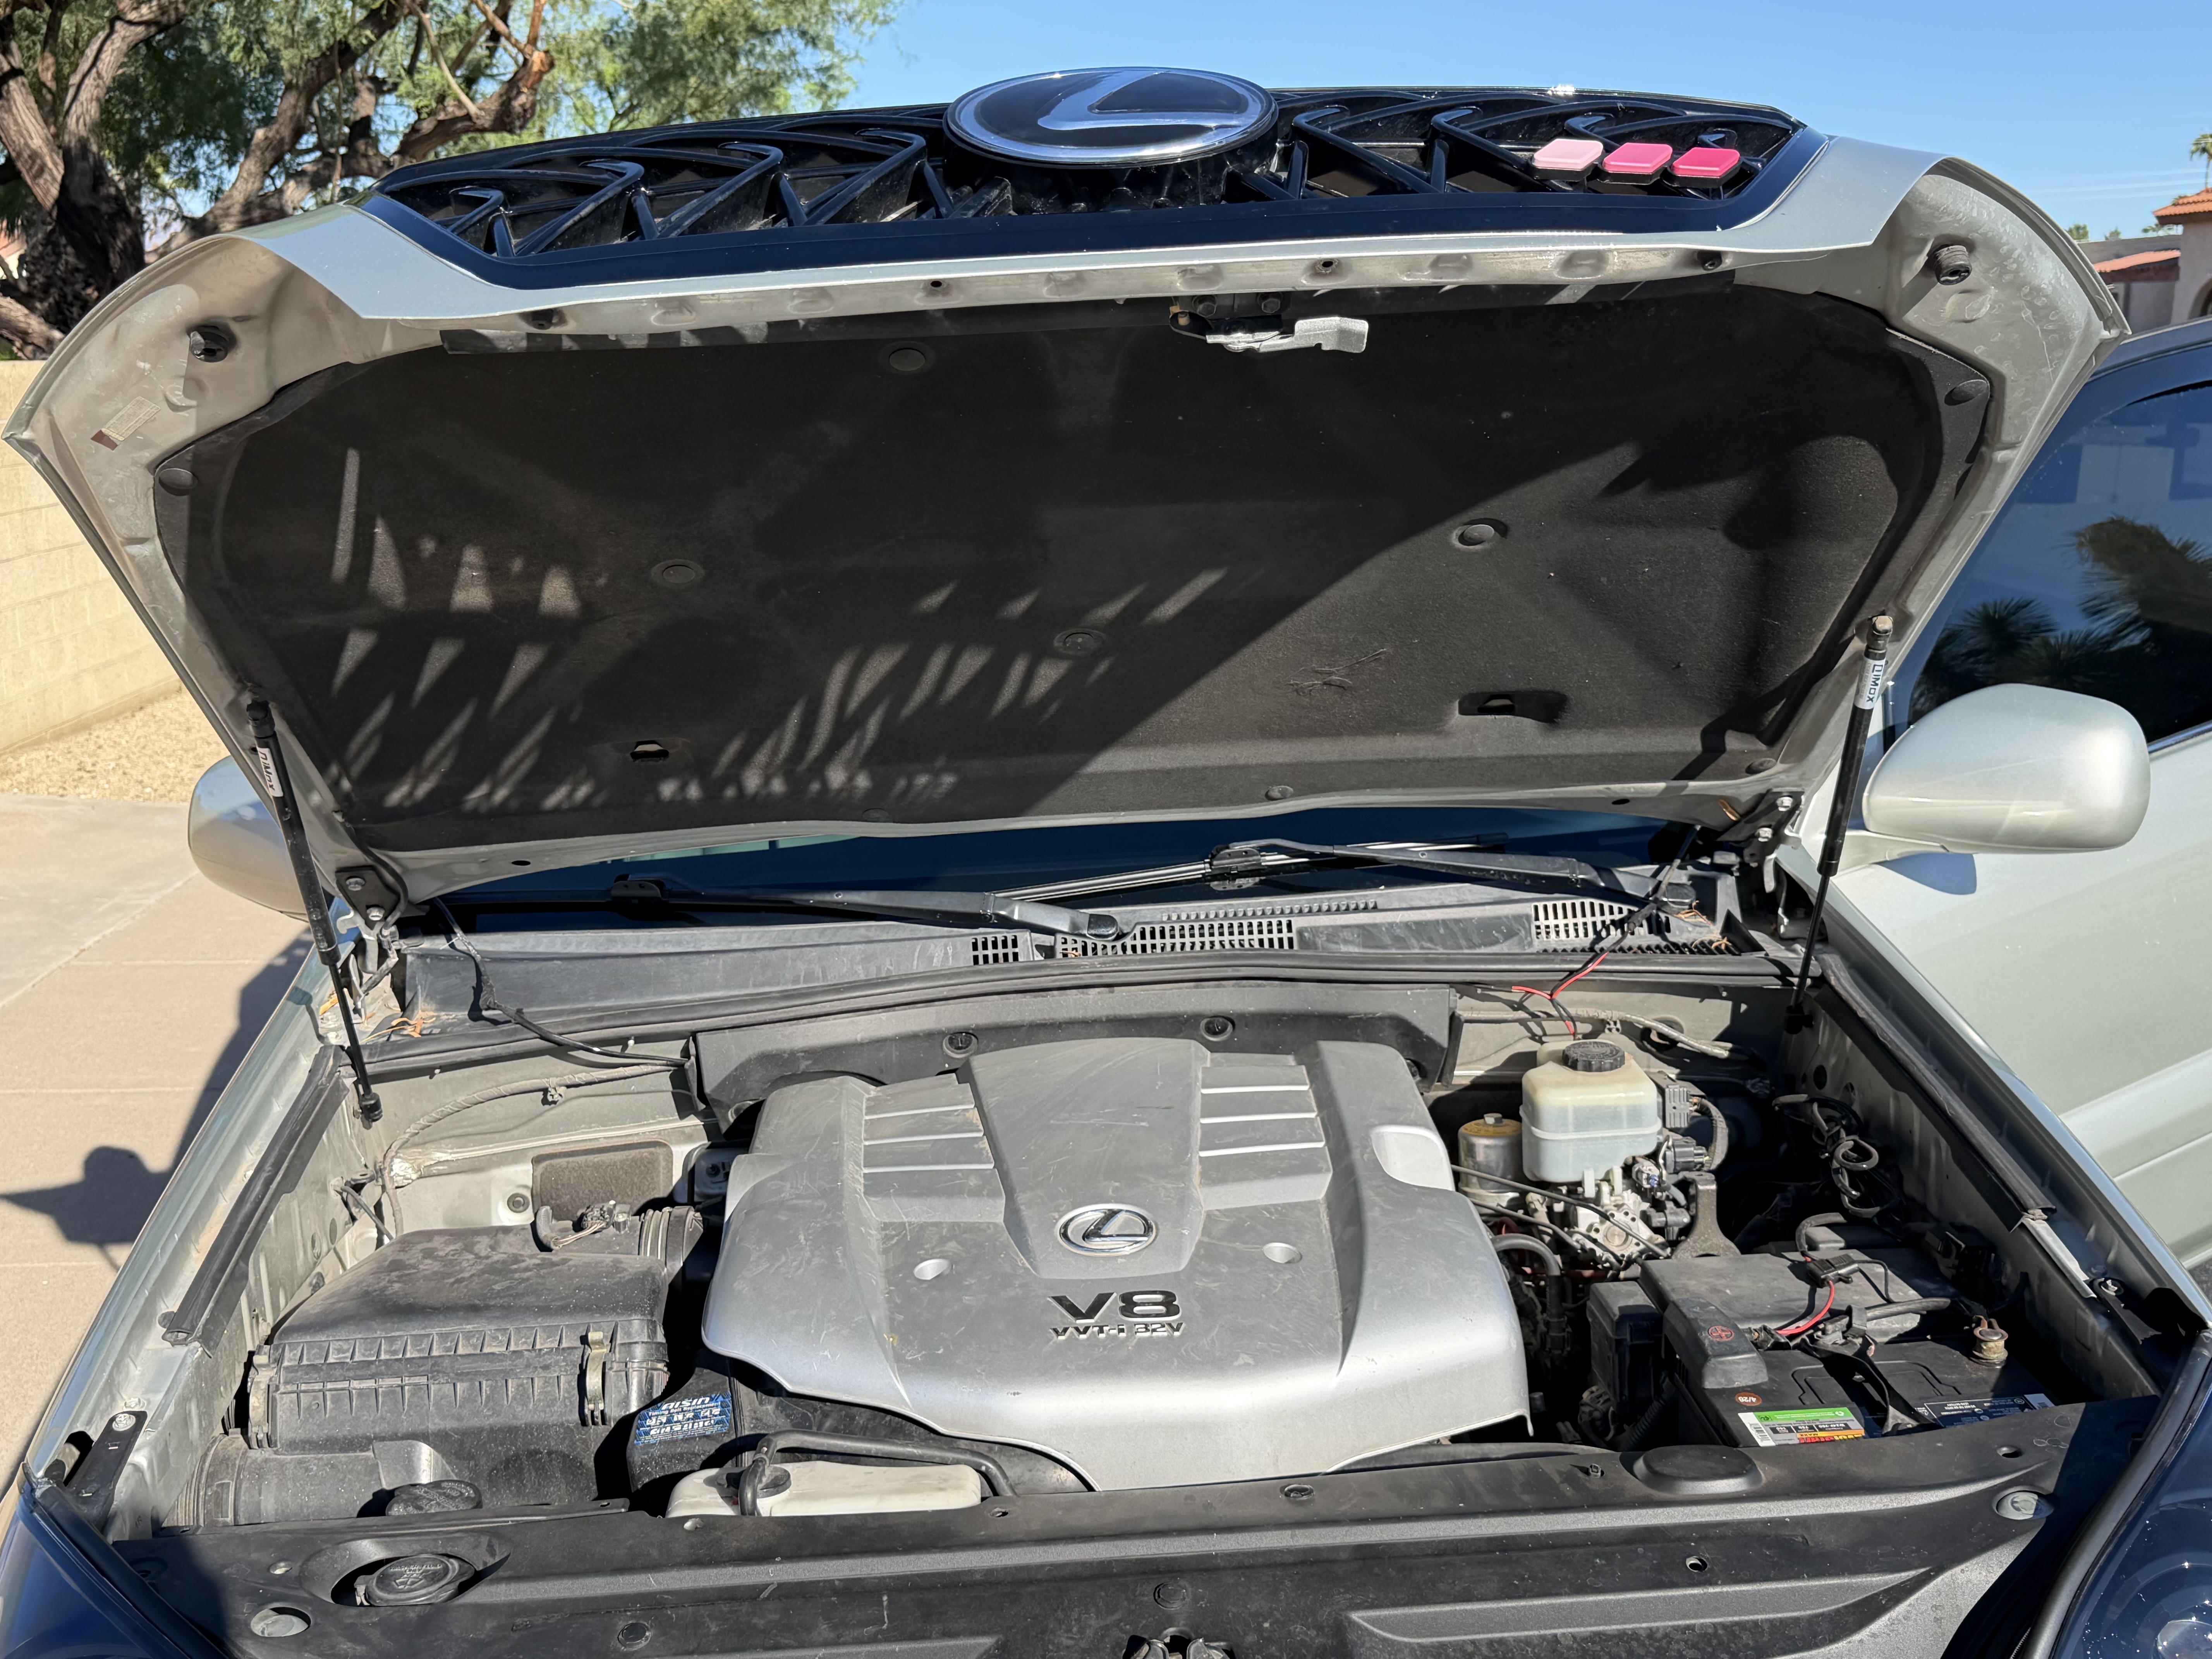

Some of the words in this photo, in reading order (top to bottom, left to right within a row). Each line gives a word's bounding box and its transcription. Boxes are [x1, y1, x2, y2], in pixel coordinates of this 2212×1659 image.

[1047, 1290, 1182, 1323] V8
[1134, 1322, 1183, 1336] 32V
[661, 1396, 710, 1410] AISIN
[683, 1401, 721, 1412] Replacement
